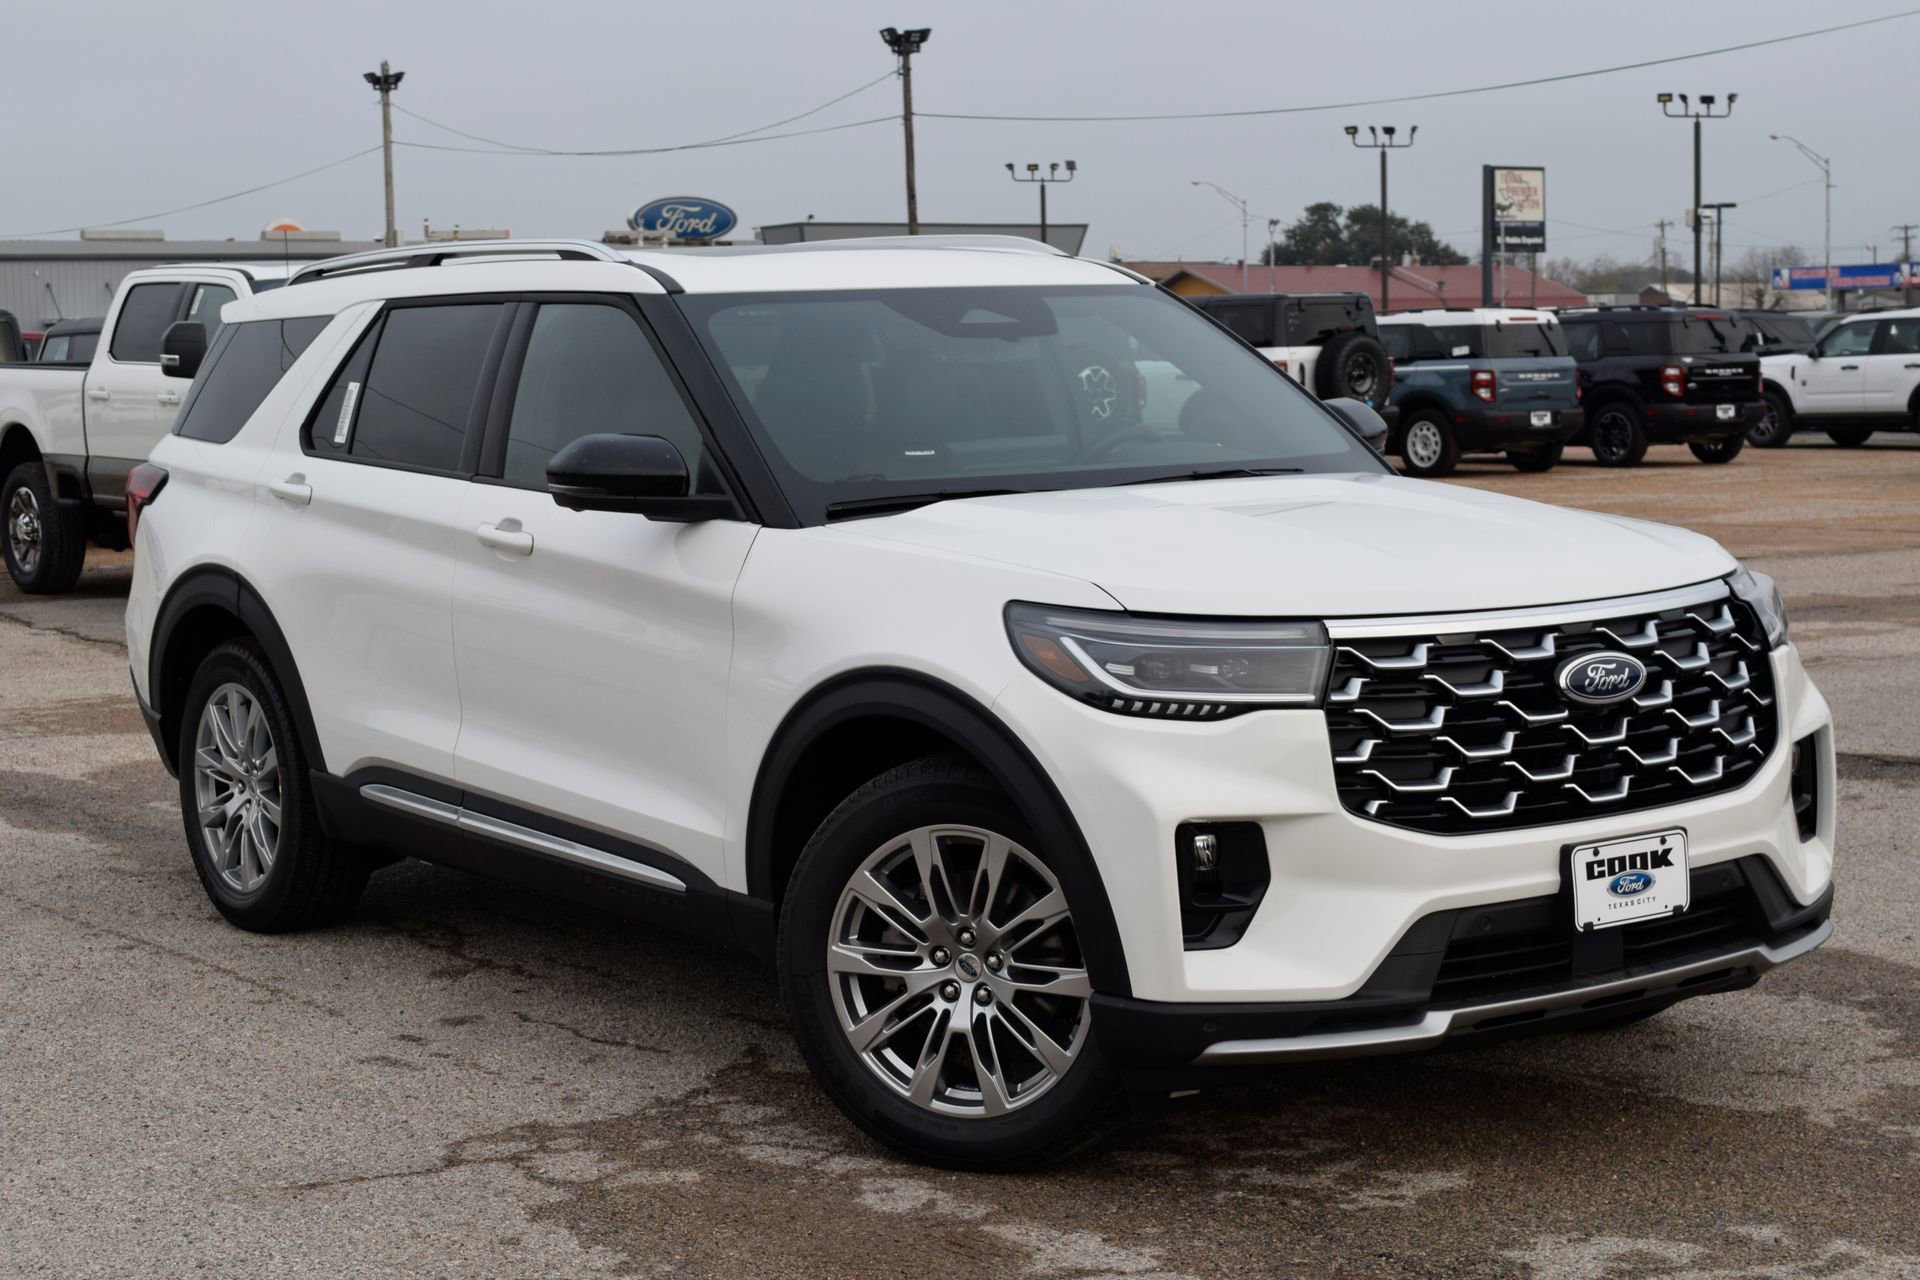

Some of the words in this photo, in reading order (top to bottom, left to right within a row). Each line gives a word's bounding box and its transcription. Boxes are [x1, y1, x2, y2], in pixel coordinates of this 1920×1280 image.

[655, 204, 717, 233] Ford
[1584, 662, 1630, 692] Ford
[1585, 847, 1675, 881] COOK
[1617, 875, 1644, 894] Ford
